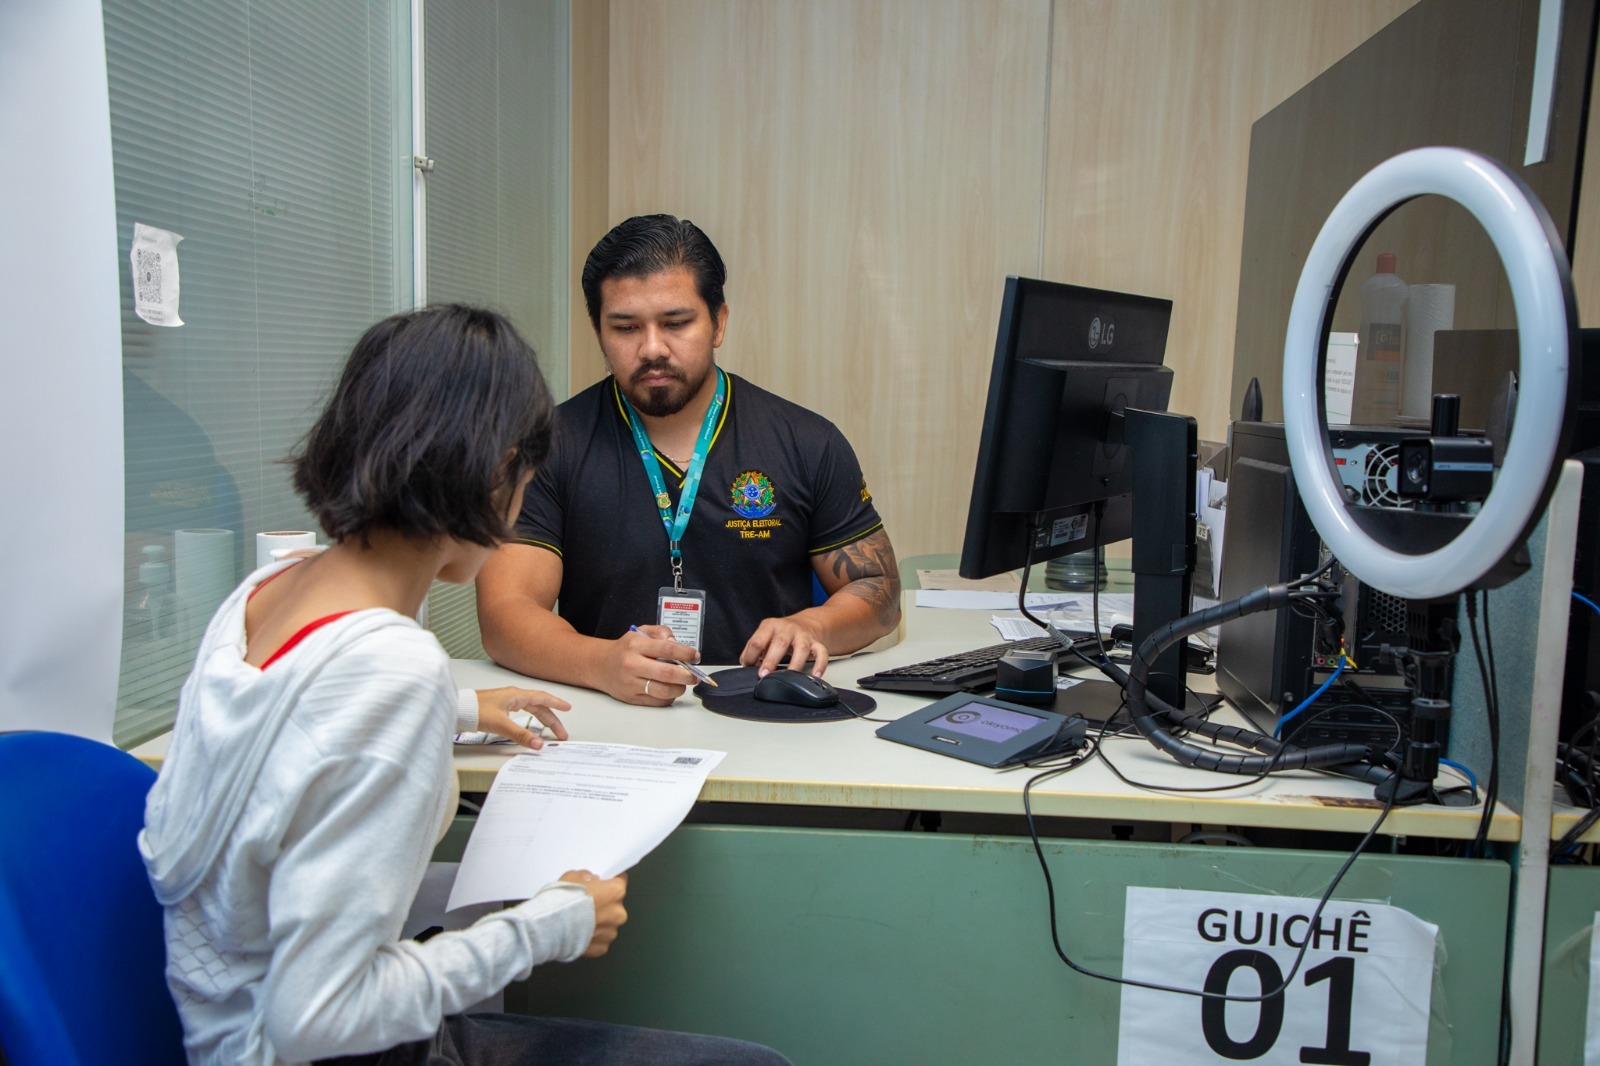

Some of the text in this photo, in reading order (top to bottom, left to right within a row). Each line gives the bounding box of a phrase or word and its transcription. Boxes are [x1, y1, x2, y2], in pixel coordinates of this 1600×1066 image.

[1100, 322, 1115, 345] LG
[725, 518, 782, 530] JUSTIÇA ELEITORAL
[740, 529, 771, 539] TRE-AM
[1197, 908, 1372, 953] GUICHÊ
[1201, 949, 1371, 1066] 01
